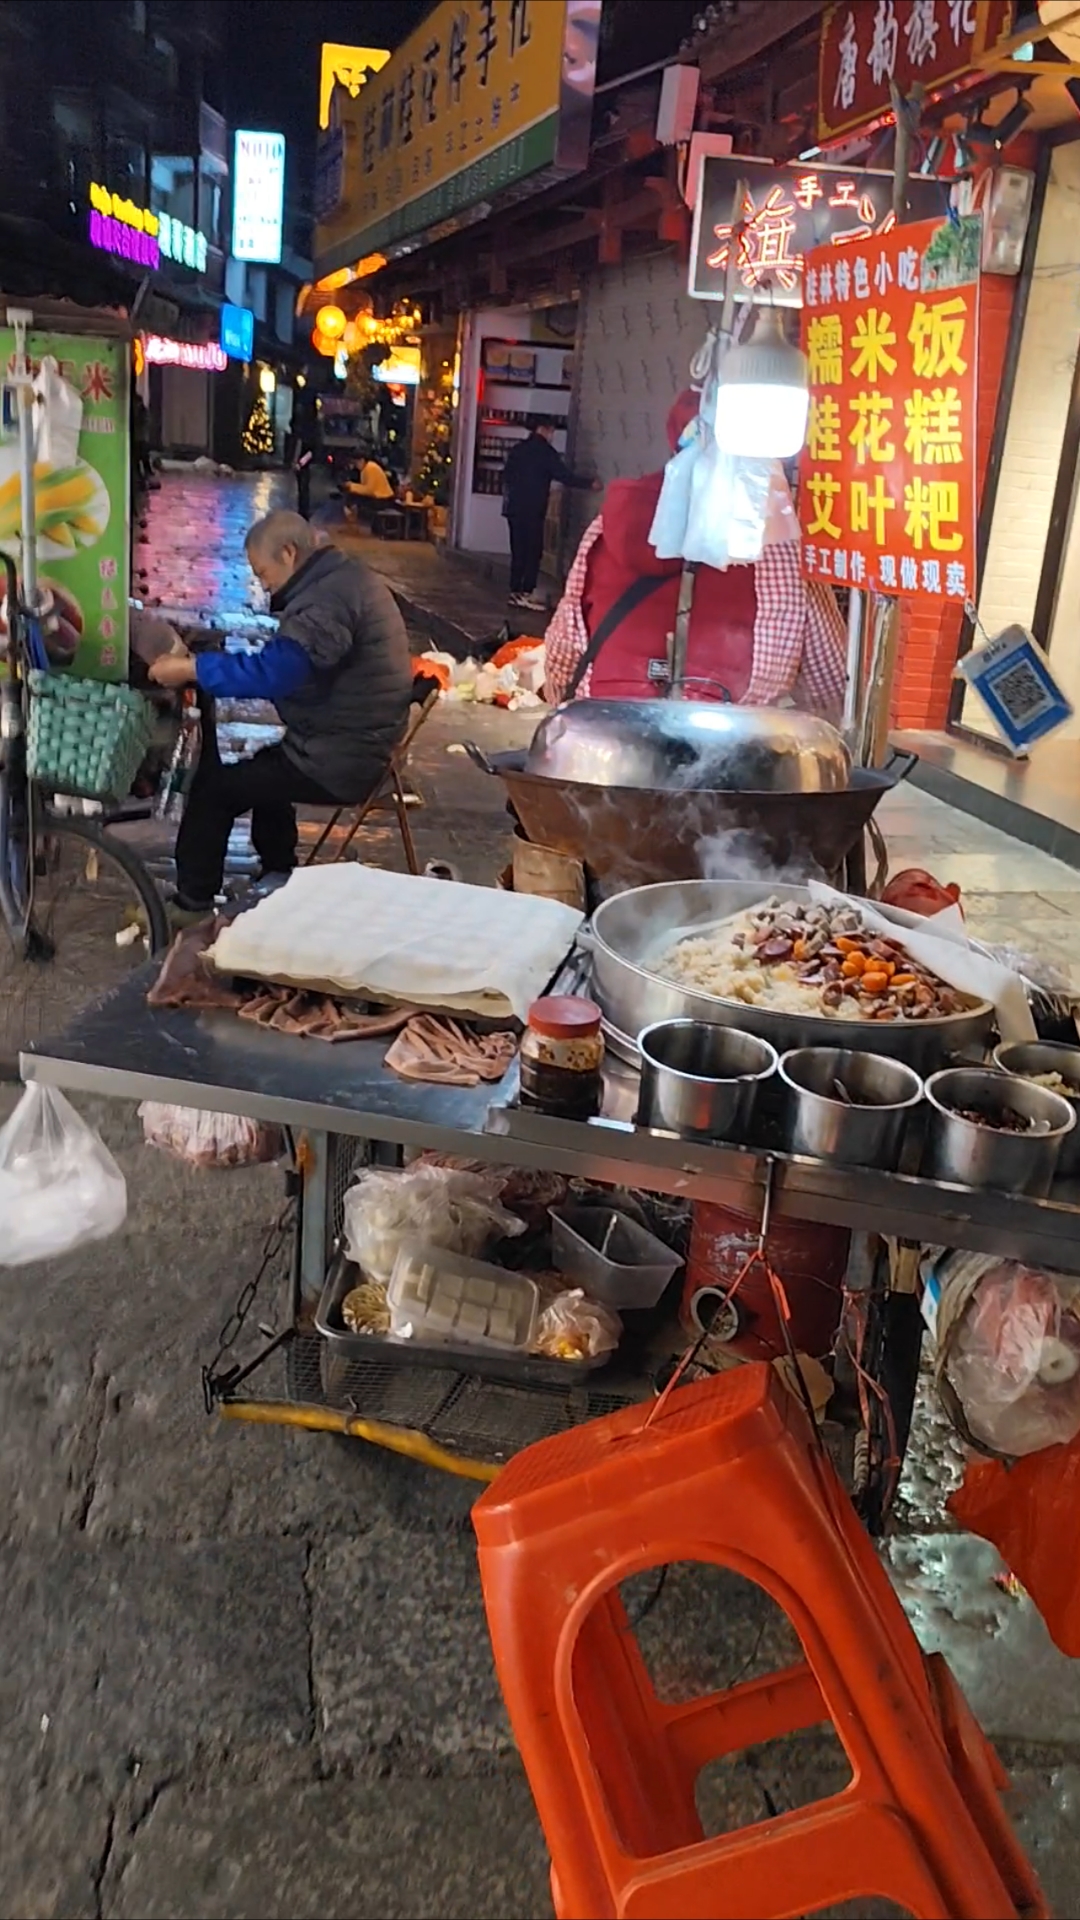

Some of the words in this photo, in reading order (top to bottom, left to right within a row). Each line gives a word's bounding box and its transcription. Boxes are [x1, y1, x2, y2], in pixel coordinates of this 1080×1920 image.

[793, 174, 860, 210] 手工
[805, 245, 919, 306] 桂林特色小吃
[807, 296, 967, 385] 糯米饭
[806, 387, 964, 465] 桂花糕
[806, 472, 964, 552] 艾叶粑
[804, 544, 866, 583] 手工制作
[879, 555, 967, 597] 现做现卖
